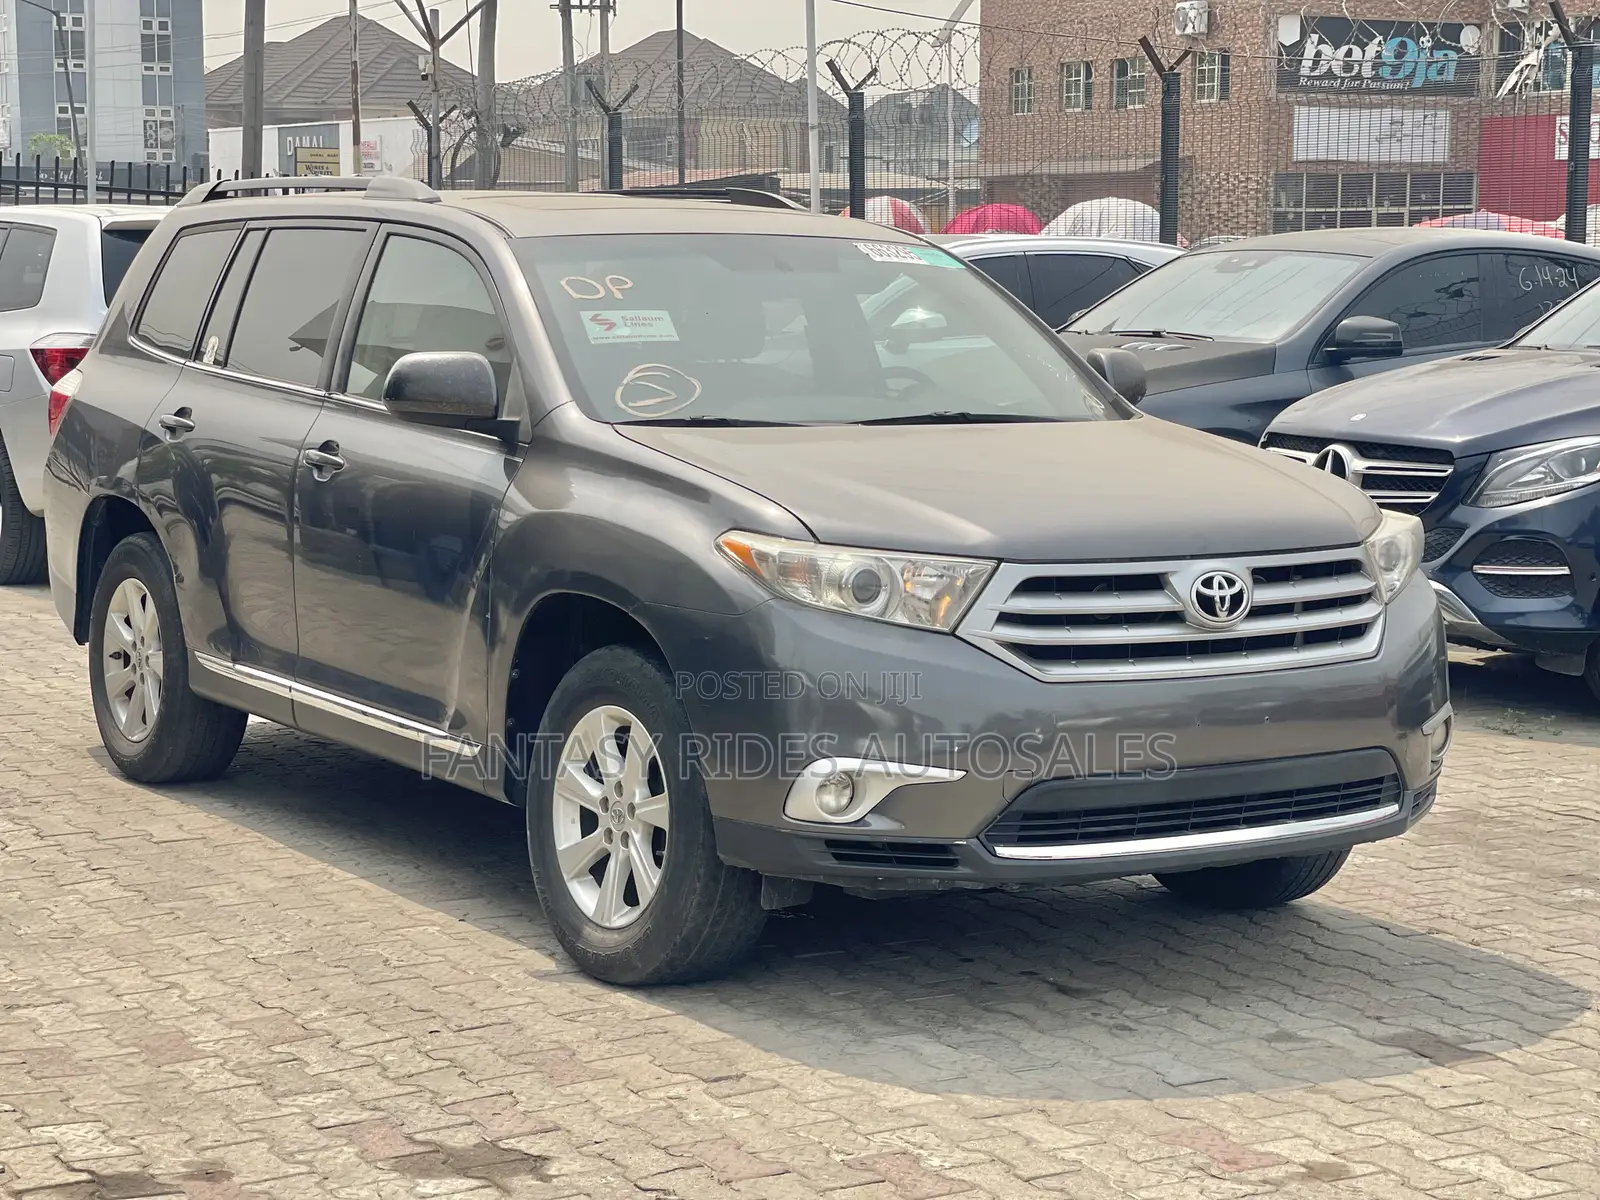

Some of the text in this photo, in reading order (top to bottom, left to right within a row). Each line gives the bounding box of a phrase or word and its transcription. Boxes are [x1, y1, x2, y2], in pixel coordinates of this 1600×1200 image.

[1298, 33, 1458, 88] bet9ja
[1299, 77, 1340, 87] Reward
[1341, 77, 1360, 90] for
